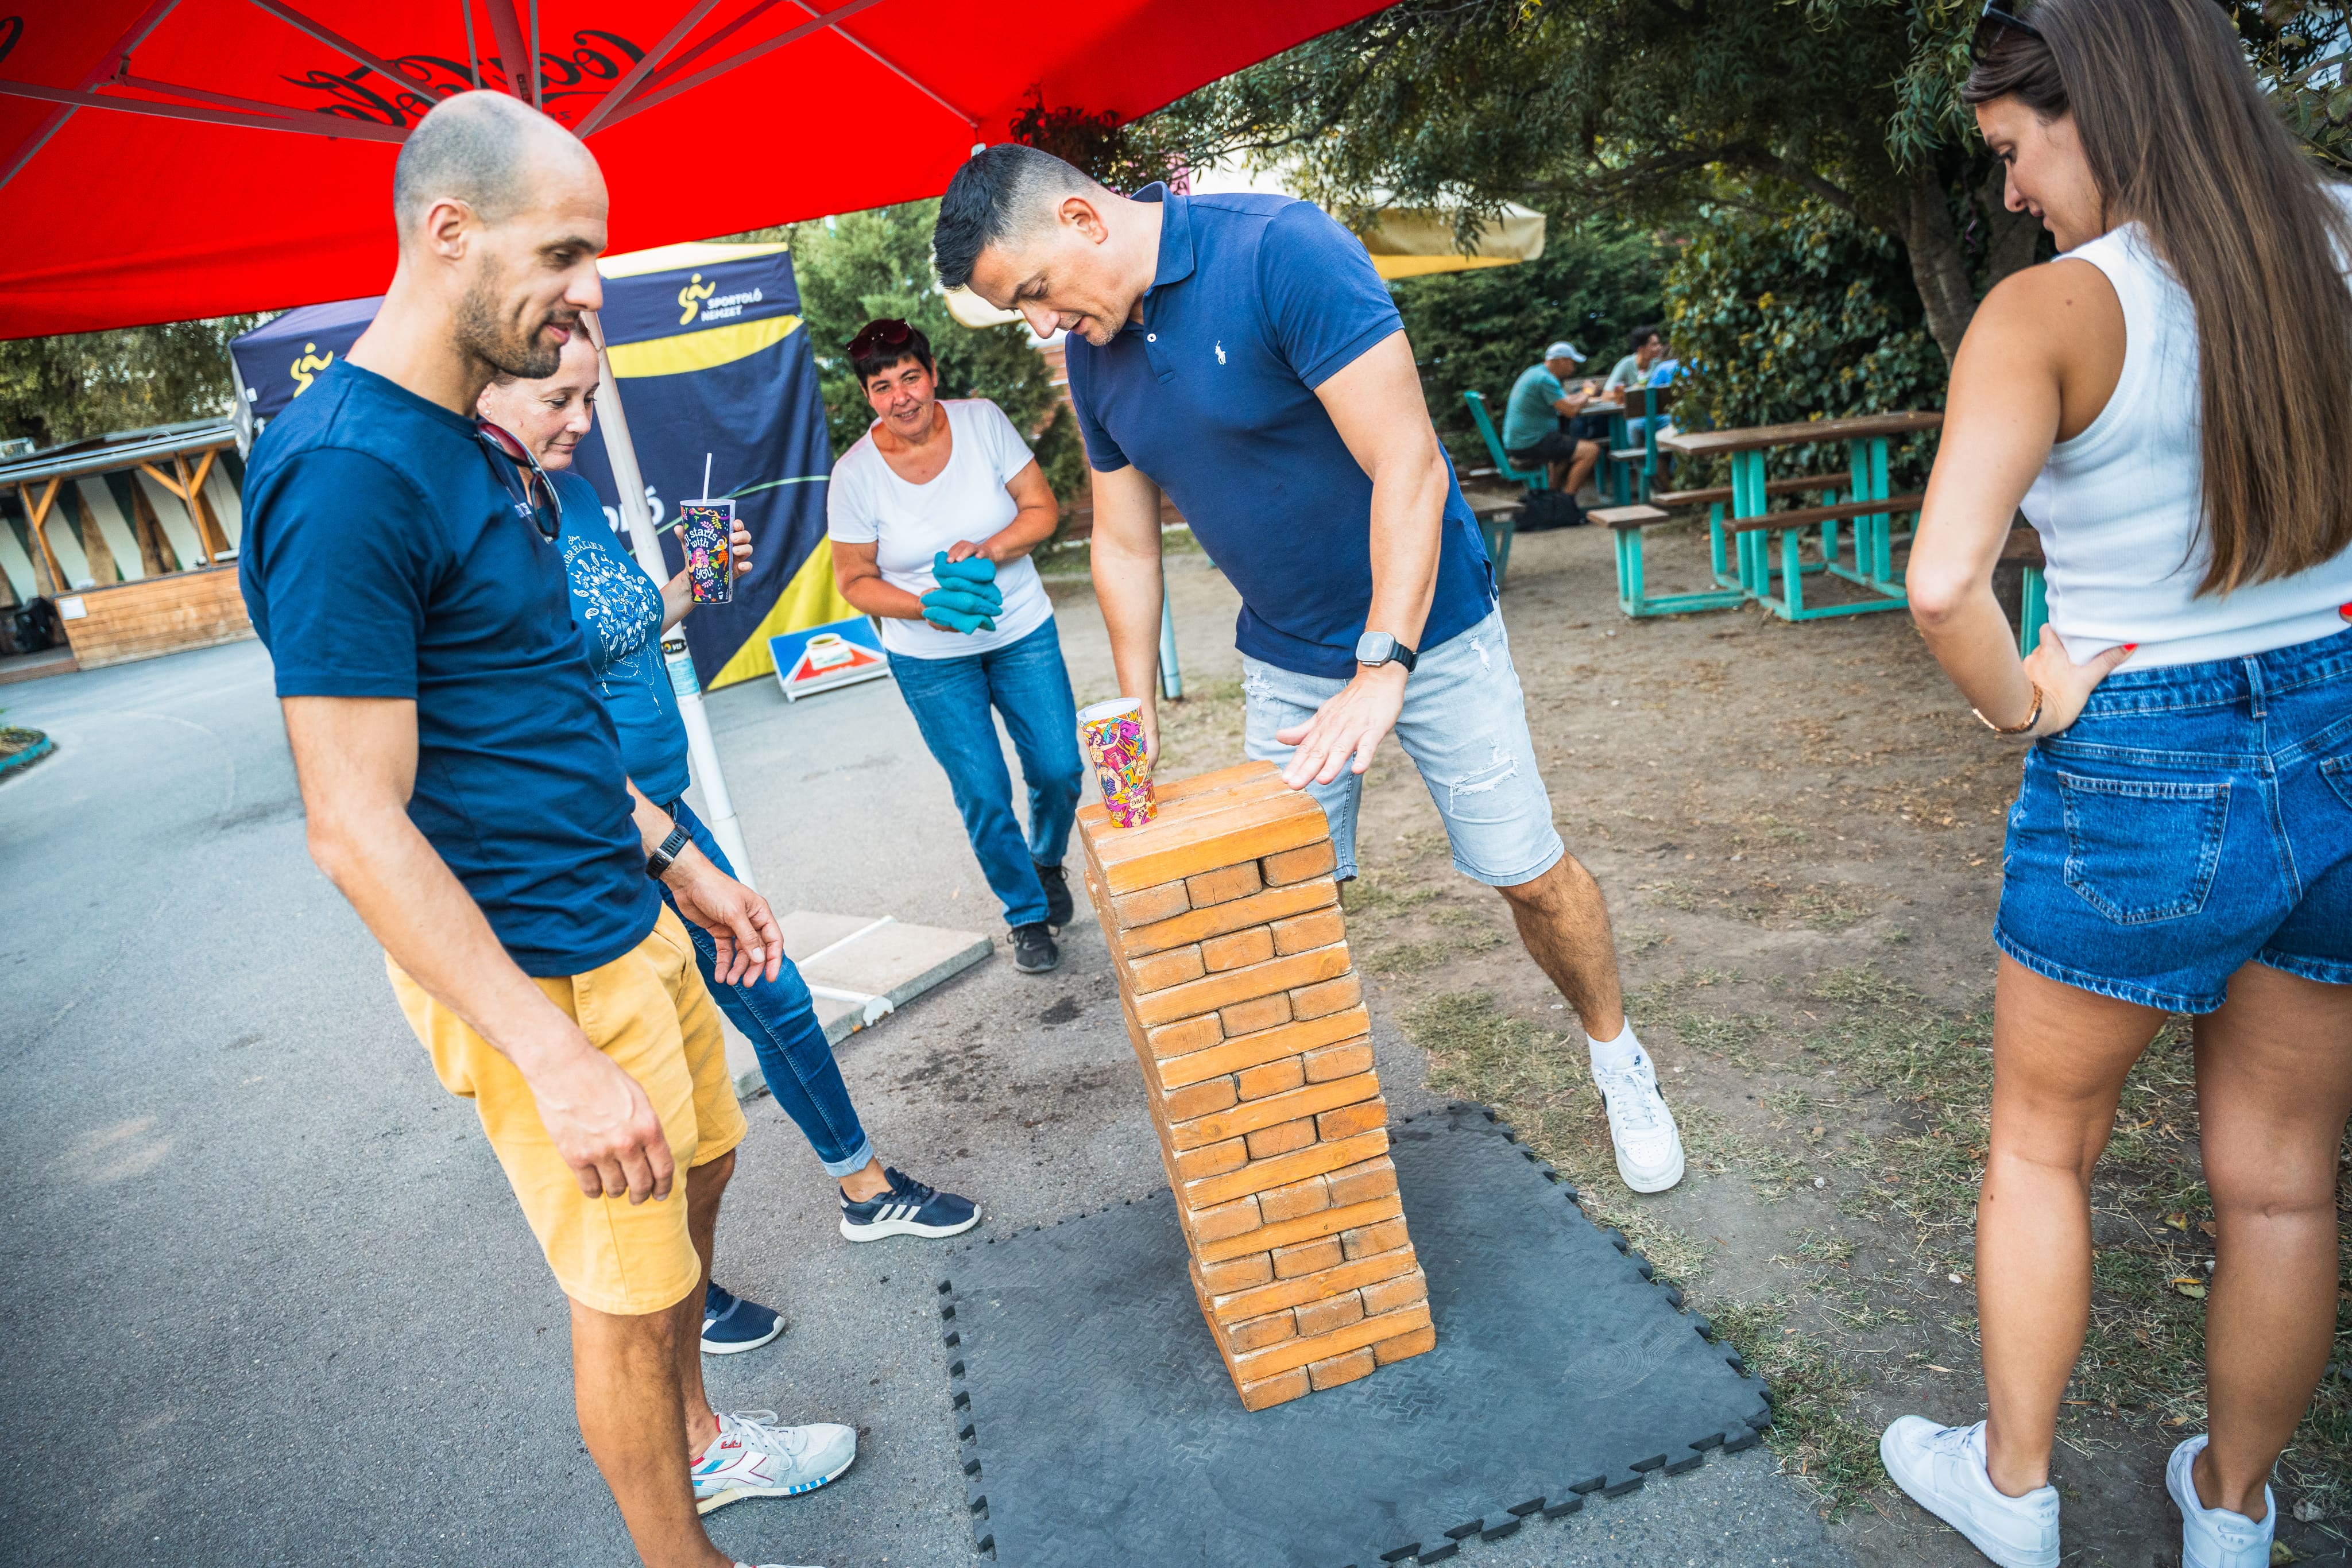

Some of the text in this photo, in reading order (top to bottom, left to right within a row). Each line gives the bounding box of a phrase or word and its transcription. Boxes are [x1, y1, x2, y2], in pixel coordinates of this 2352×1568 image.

[707, 288, 763, 309] SPORTOLÓ
[701, 305, 742, 322] NEMZET
[690, 527, 718, 541] starts
[690, 537, 709, 548] with
[564, 541, 606, 571] NBREAKABLE
[1131, 797, 1143, 806] BANG
[2219, 1534, 2244, 1544] AIR
